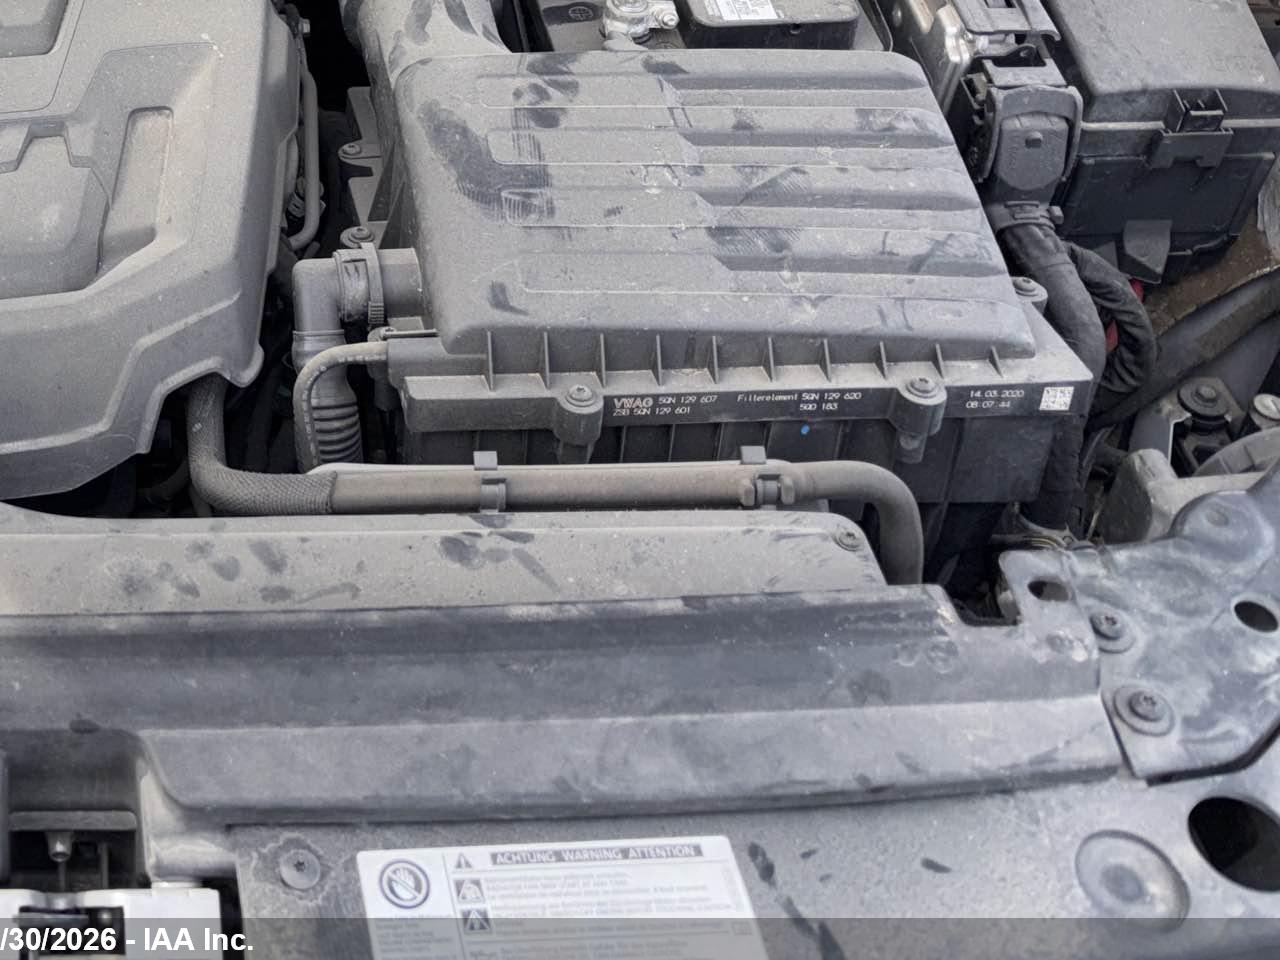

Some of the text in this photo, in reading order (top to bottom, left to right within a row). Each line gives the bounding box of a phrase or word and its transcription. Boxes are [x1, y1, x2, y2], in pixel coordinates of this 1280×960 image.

[737, 393, 798, 403] Filterelement
[823, 392, 841, 401] 129
[843, 391, 862, 400] 620
[970, 390, 1024, 398] 14.03.2020
[613, 397, 654, 409] VWAG
[680, 395, 697, 404] 129
[699, 394, 718, 404] 607
[655, 406, 672, 415] 129
[674, 406, 691, 415] 601
[493, 844, 696, 866] ACHTUNG WARNING ATTENTION
